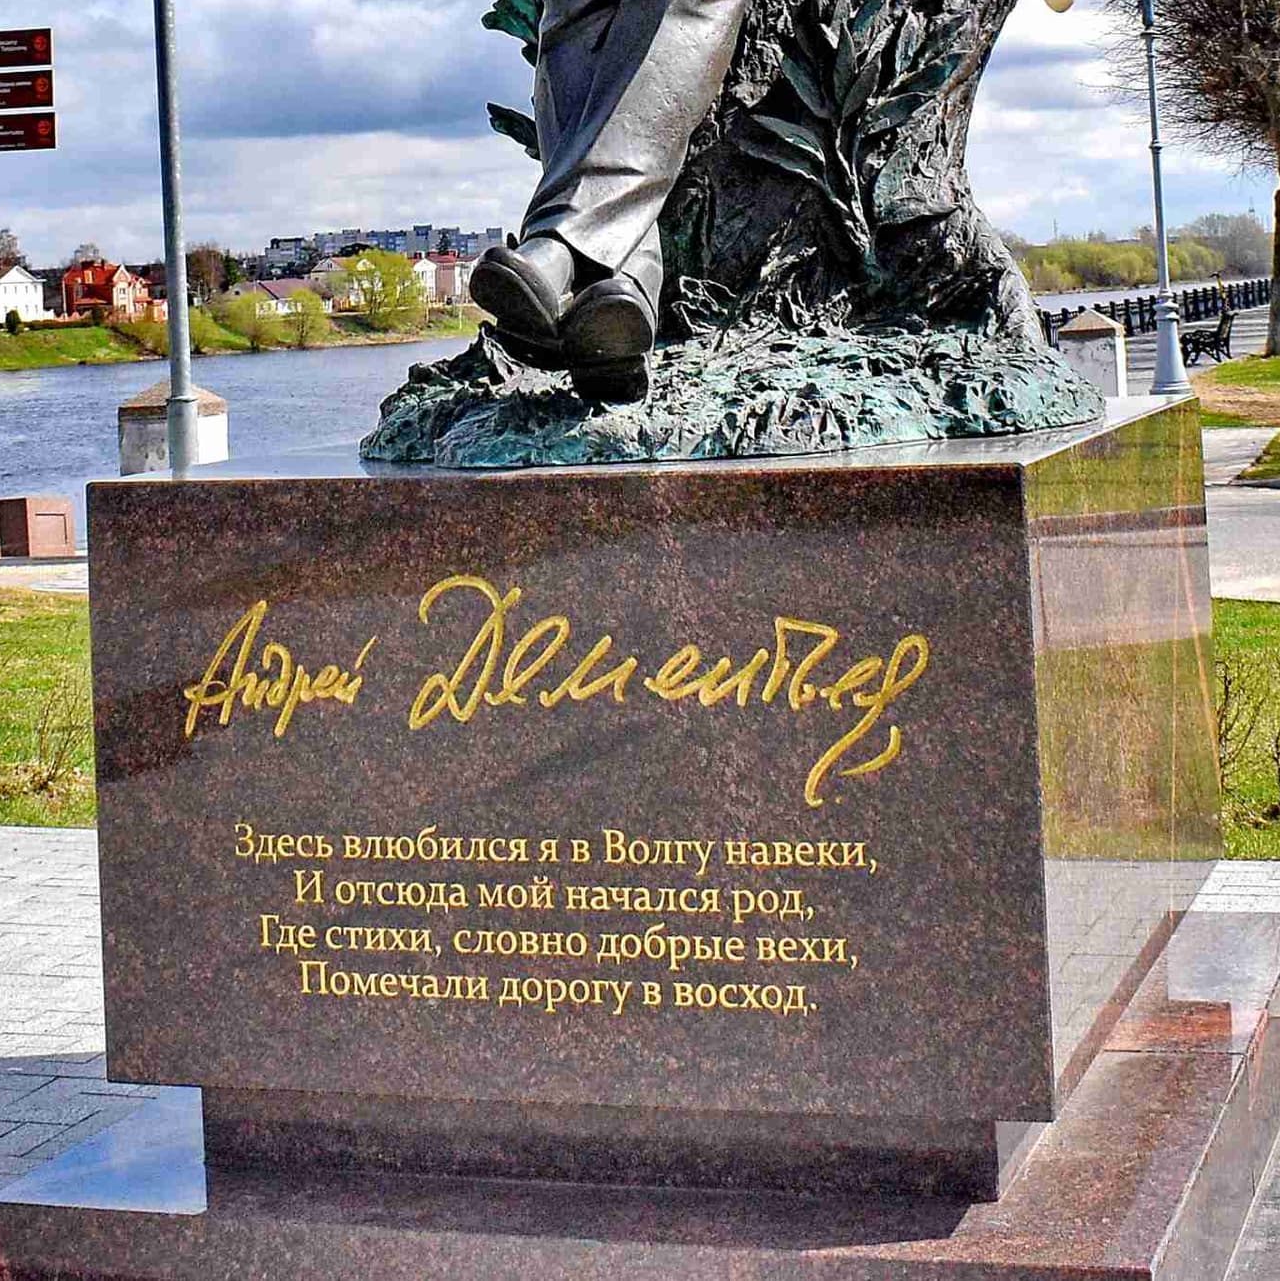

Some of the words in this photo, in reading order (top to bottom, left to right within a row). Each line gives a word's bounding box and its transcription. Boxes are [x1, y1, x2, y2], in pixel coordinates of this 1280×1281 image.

[183, 599, 376, 738] Андрей
[408, 574, 929, 807] Дементьев
[234, 823, 333, 864] Здесь
[343, 823, 530, 863] влюбился
[538, 840, 560, 864] я
[571, 838, 591, 864] в
[603, 829, 716, 876] Волгу
[725, 840, 877, 874] навеки,
[294, 870, 324, 903] И
[335, 881, 469, 913] отсюда
[479, 876, 555, 909] мой
[565, 885, 721, 912] начался
[732, 889, 815, 924] род,
[260, 914, 317, 955] Где
[325, 925, 442, 957] стихи,
[453, 930, 588, 957] словно
[596, 923, 746, 971] добрые
[757, 937, 859, 970] вехи,
[299, 960, 489, 1000] Помечали
[499, 978, 633, 1016] дорогу
[644, 981, 662, 1007] в
[673, 982, 819, 1017] восход.
